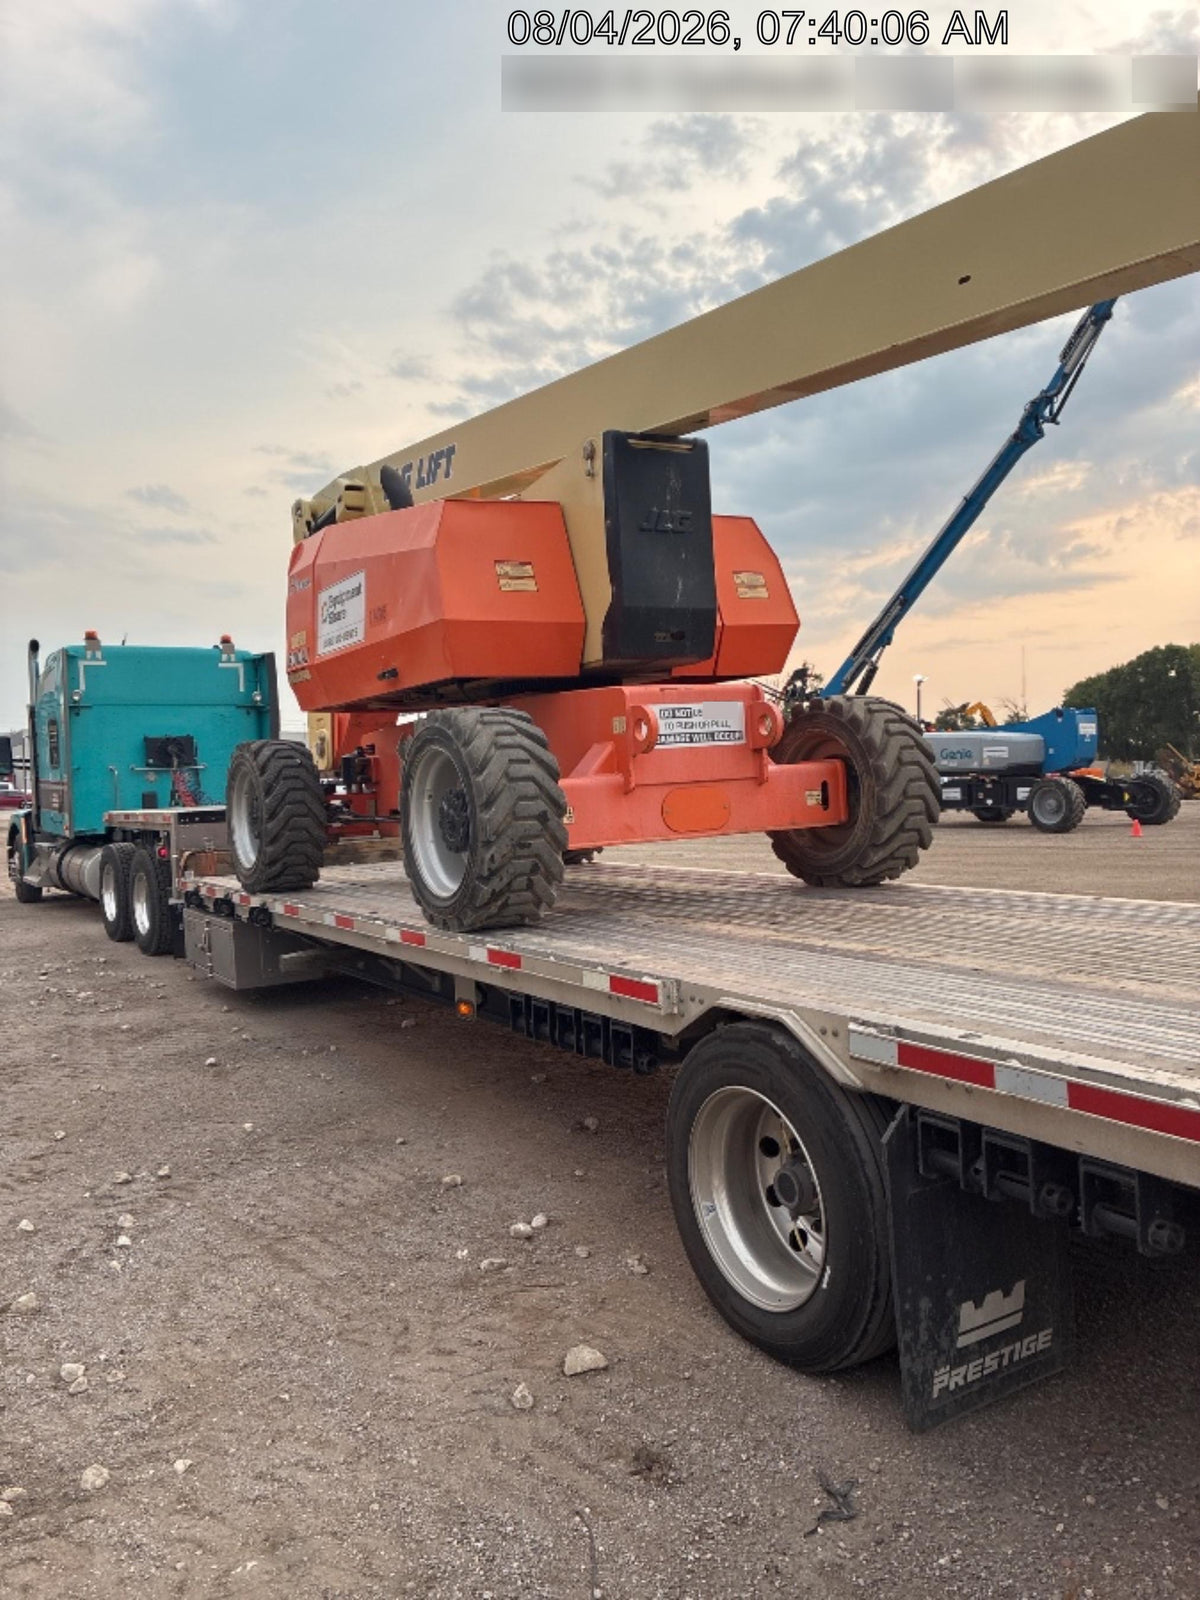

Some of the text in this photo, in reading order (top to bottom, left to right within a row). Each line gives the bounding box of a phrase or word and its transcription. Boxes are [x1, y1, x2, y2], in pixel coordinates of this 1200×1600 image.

[415, 444, 456, 489] LIFT
[674, 708, 692, 718] NOT
[676, 721, 697, 730] PUSH
[692, 732, 712, 742] WILL
[940, 748, 973, 761] Genie
[932, 1328, 1053, 1399] PRESTIGE
